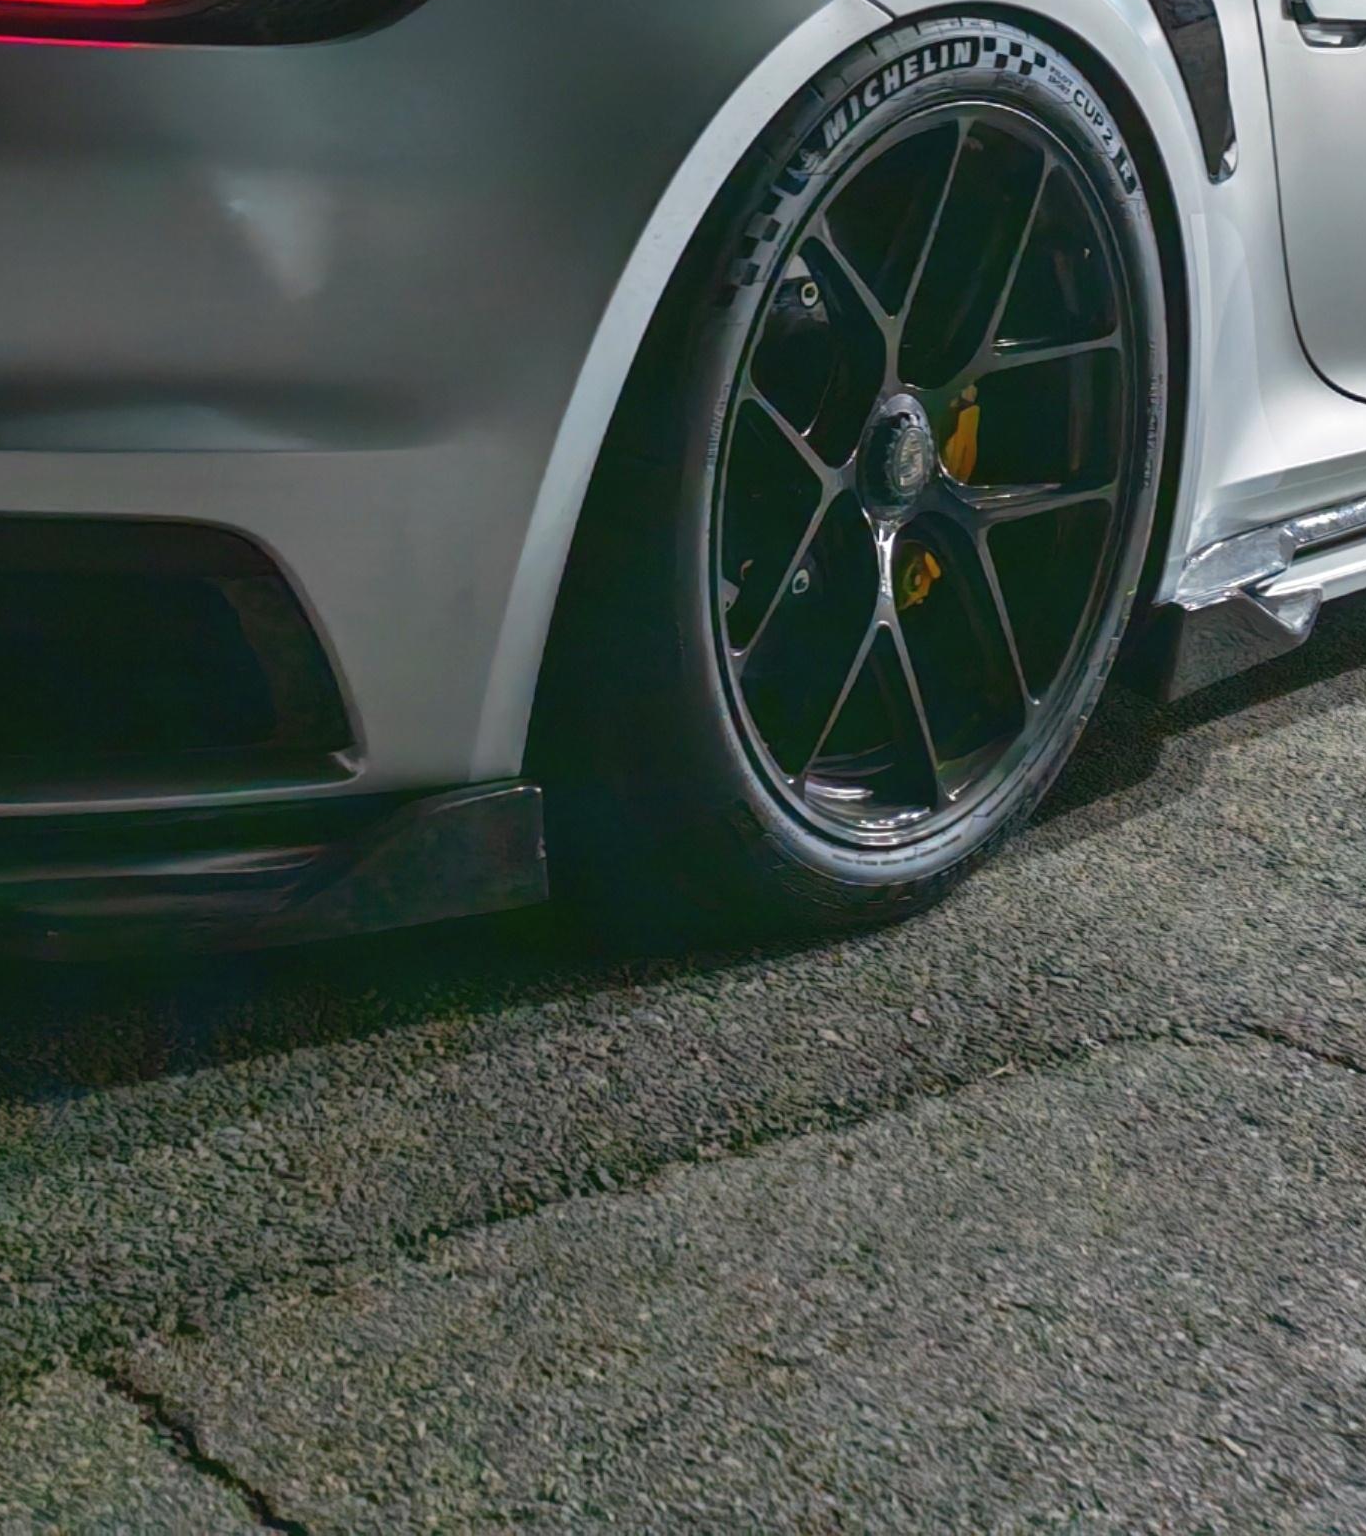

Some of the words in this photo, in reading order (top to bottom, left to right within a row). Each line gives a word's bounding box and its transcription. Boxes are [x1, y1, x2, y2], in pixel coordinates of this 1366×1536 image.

[822, 39, 973, 148] MICHELIN
[1073, 89, 1104, 127] CUP
[1101, 124, 1114, 146] 2
